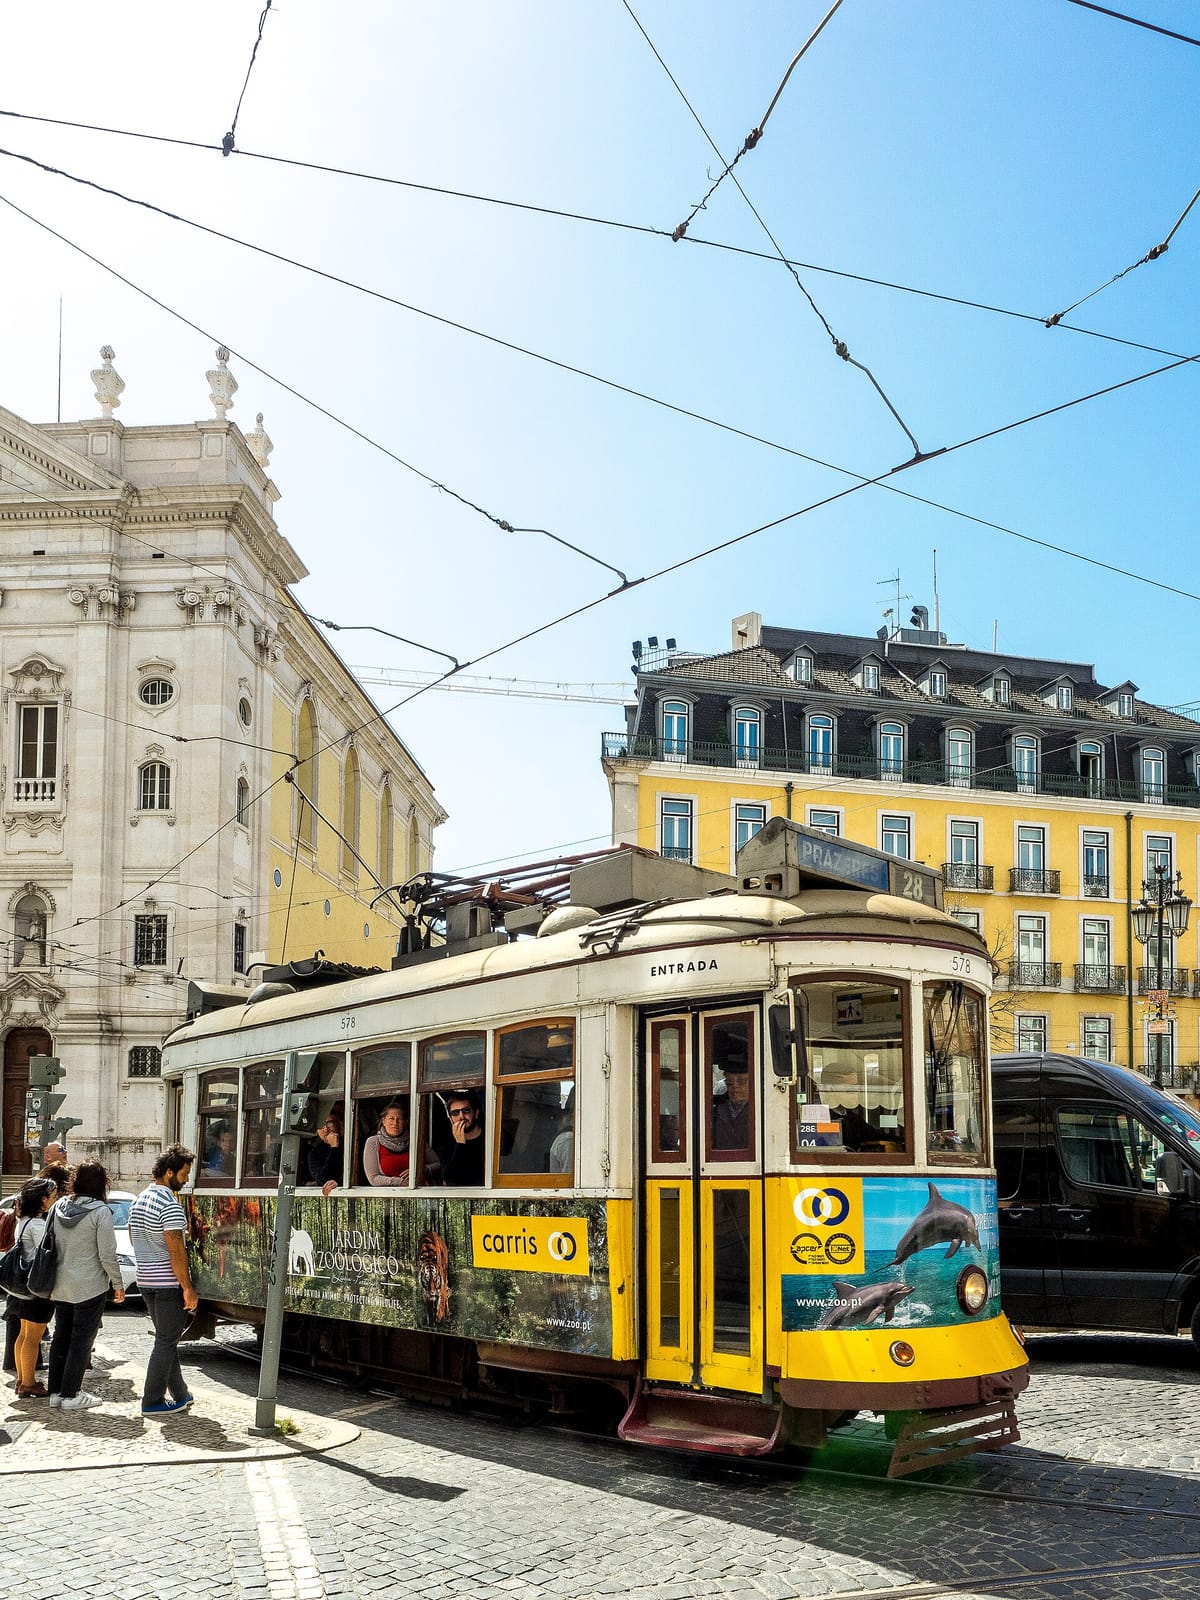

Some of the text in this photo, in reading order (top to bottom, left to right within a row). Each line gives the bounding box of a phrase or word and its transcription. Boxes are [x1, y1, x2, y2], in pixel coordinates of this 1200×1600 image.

[802, 840, 879, 881] PRAZERES
[902, 871, 923, 900] 28
[650, 959, 718, 977] ENTRADA
[952, 956, 971, 974] 578
[340, 1016, 356, 1030] 578
[800, 1125, 816, 1133] 28E
[331, 1229, 381, 1251] JARDIM
[482, 1227, 538, 1255] carris
[316, 1249, 399, 1276] ZOOLÓGICO
[795, 1296, 863, 1309] www.zoo.pt
[546, 1317, 591, 1332] www.zoo.pt
